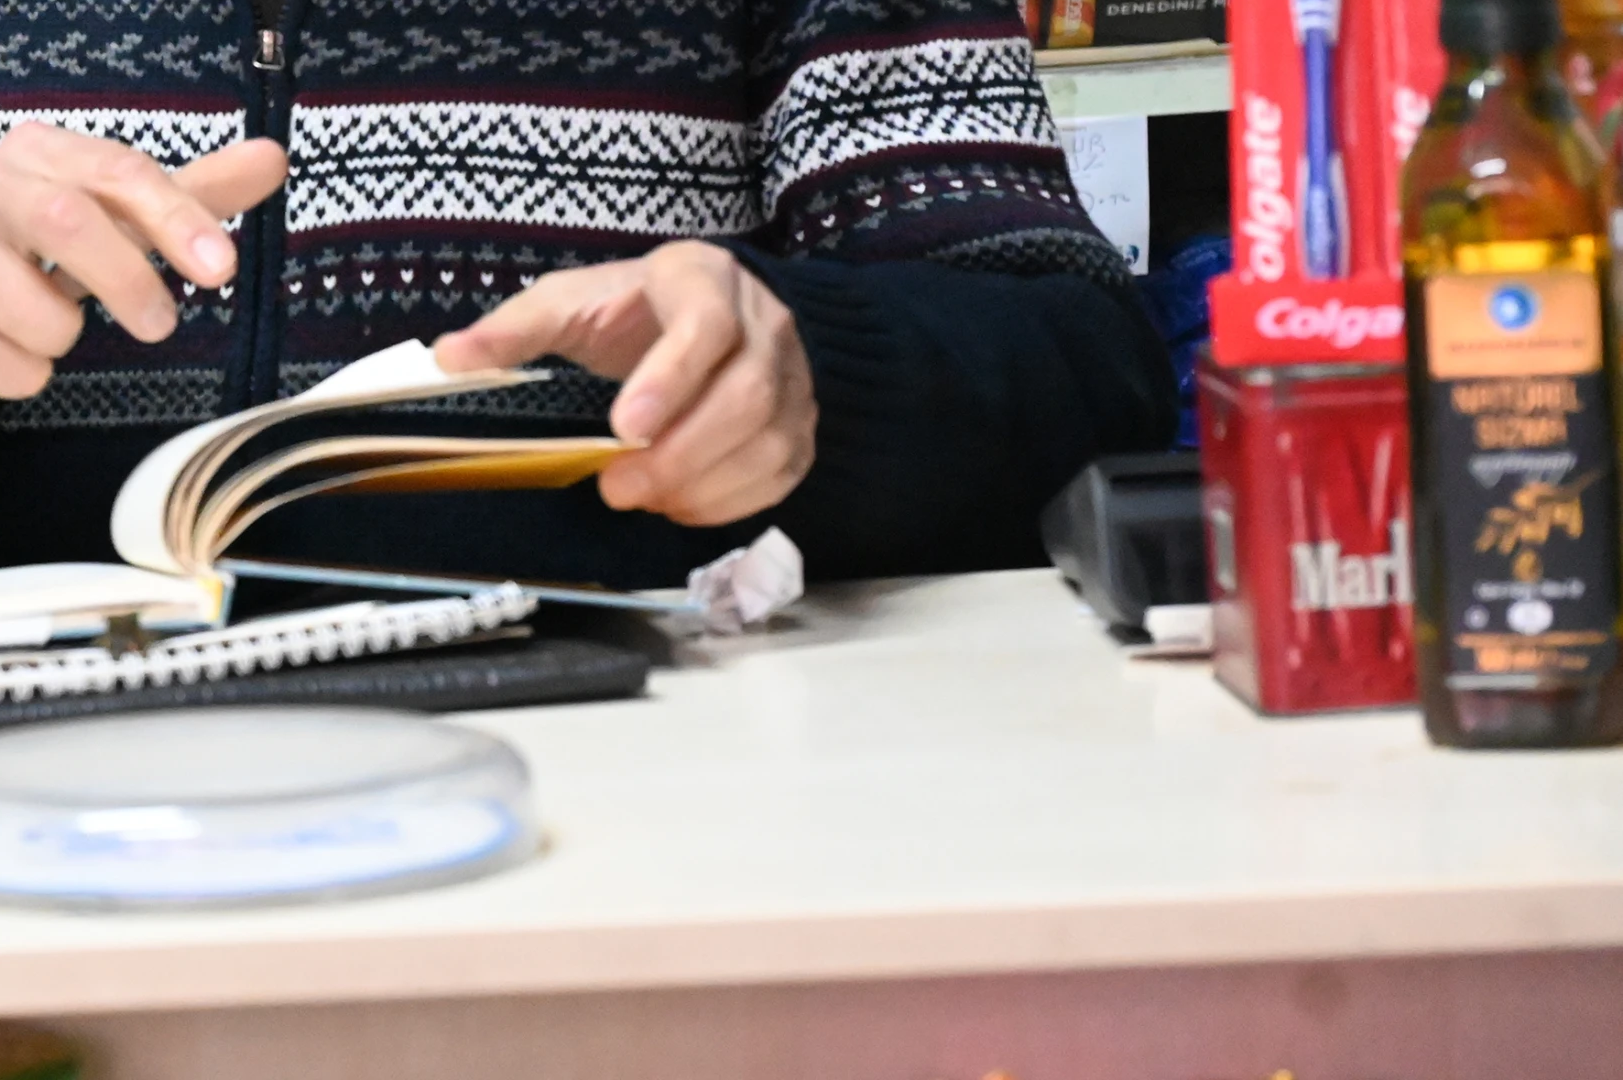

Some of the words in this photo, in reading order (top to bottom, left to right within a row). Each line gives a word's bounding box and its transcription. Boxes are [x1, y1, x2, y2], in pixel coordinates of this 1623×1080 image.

[1244, 92, 1295, 285] olgate
[1254, 295, 1406, 349] Colga
[1290, 517, 1412, 611] Marl
